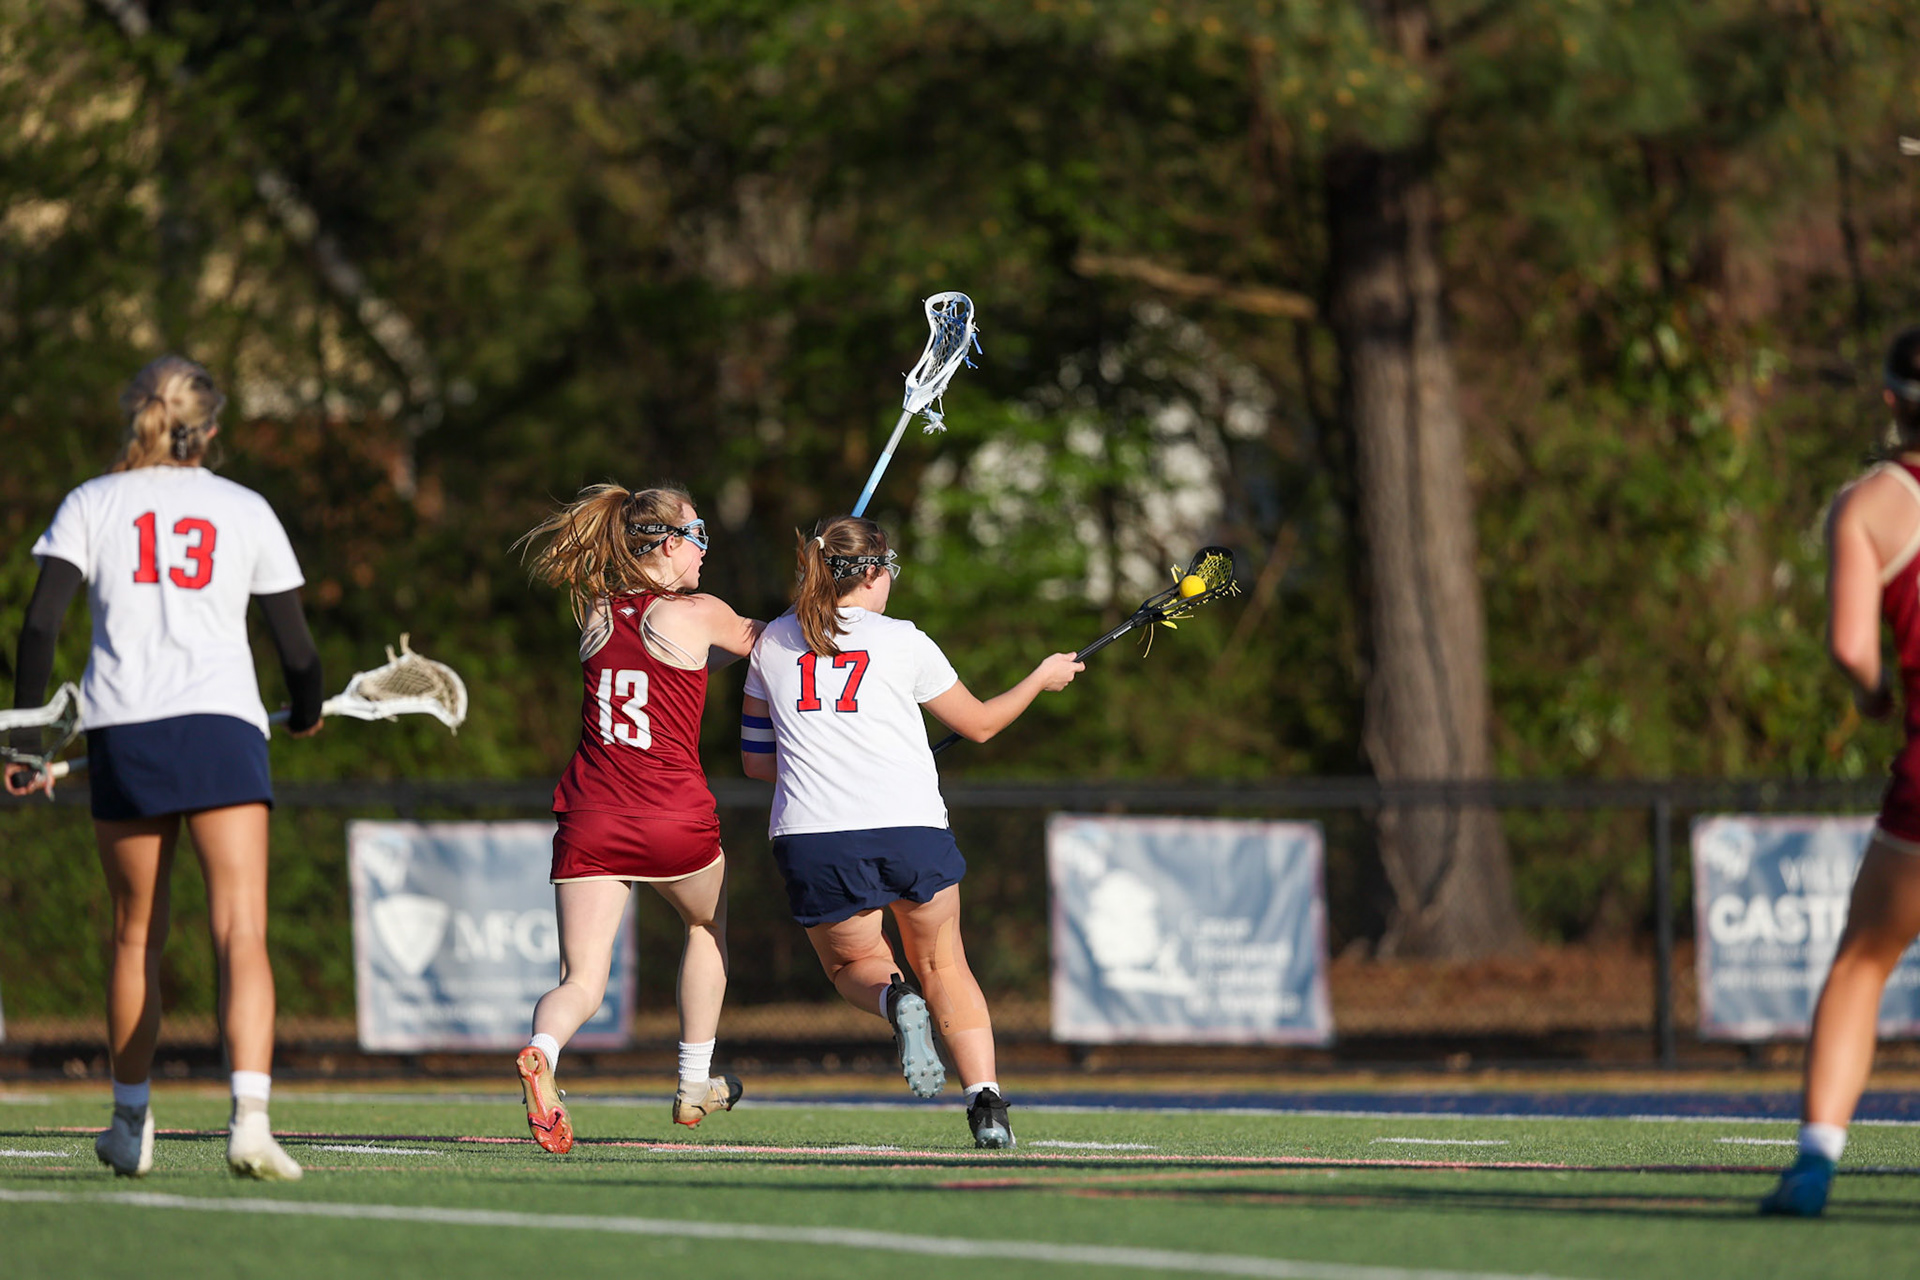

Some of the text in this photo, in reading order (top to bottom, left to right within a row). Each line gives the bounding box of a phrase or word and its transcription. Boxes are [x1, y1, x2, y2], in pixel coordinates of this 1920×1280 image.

[133, 510, 217, 590] 13
[851, 563, 870, 575] ST
[596, 668, 652, 750] 13
[797, 650, 870, 712] 17
